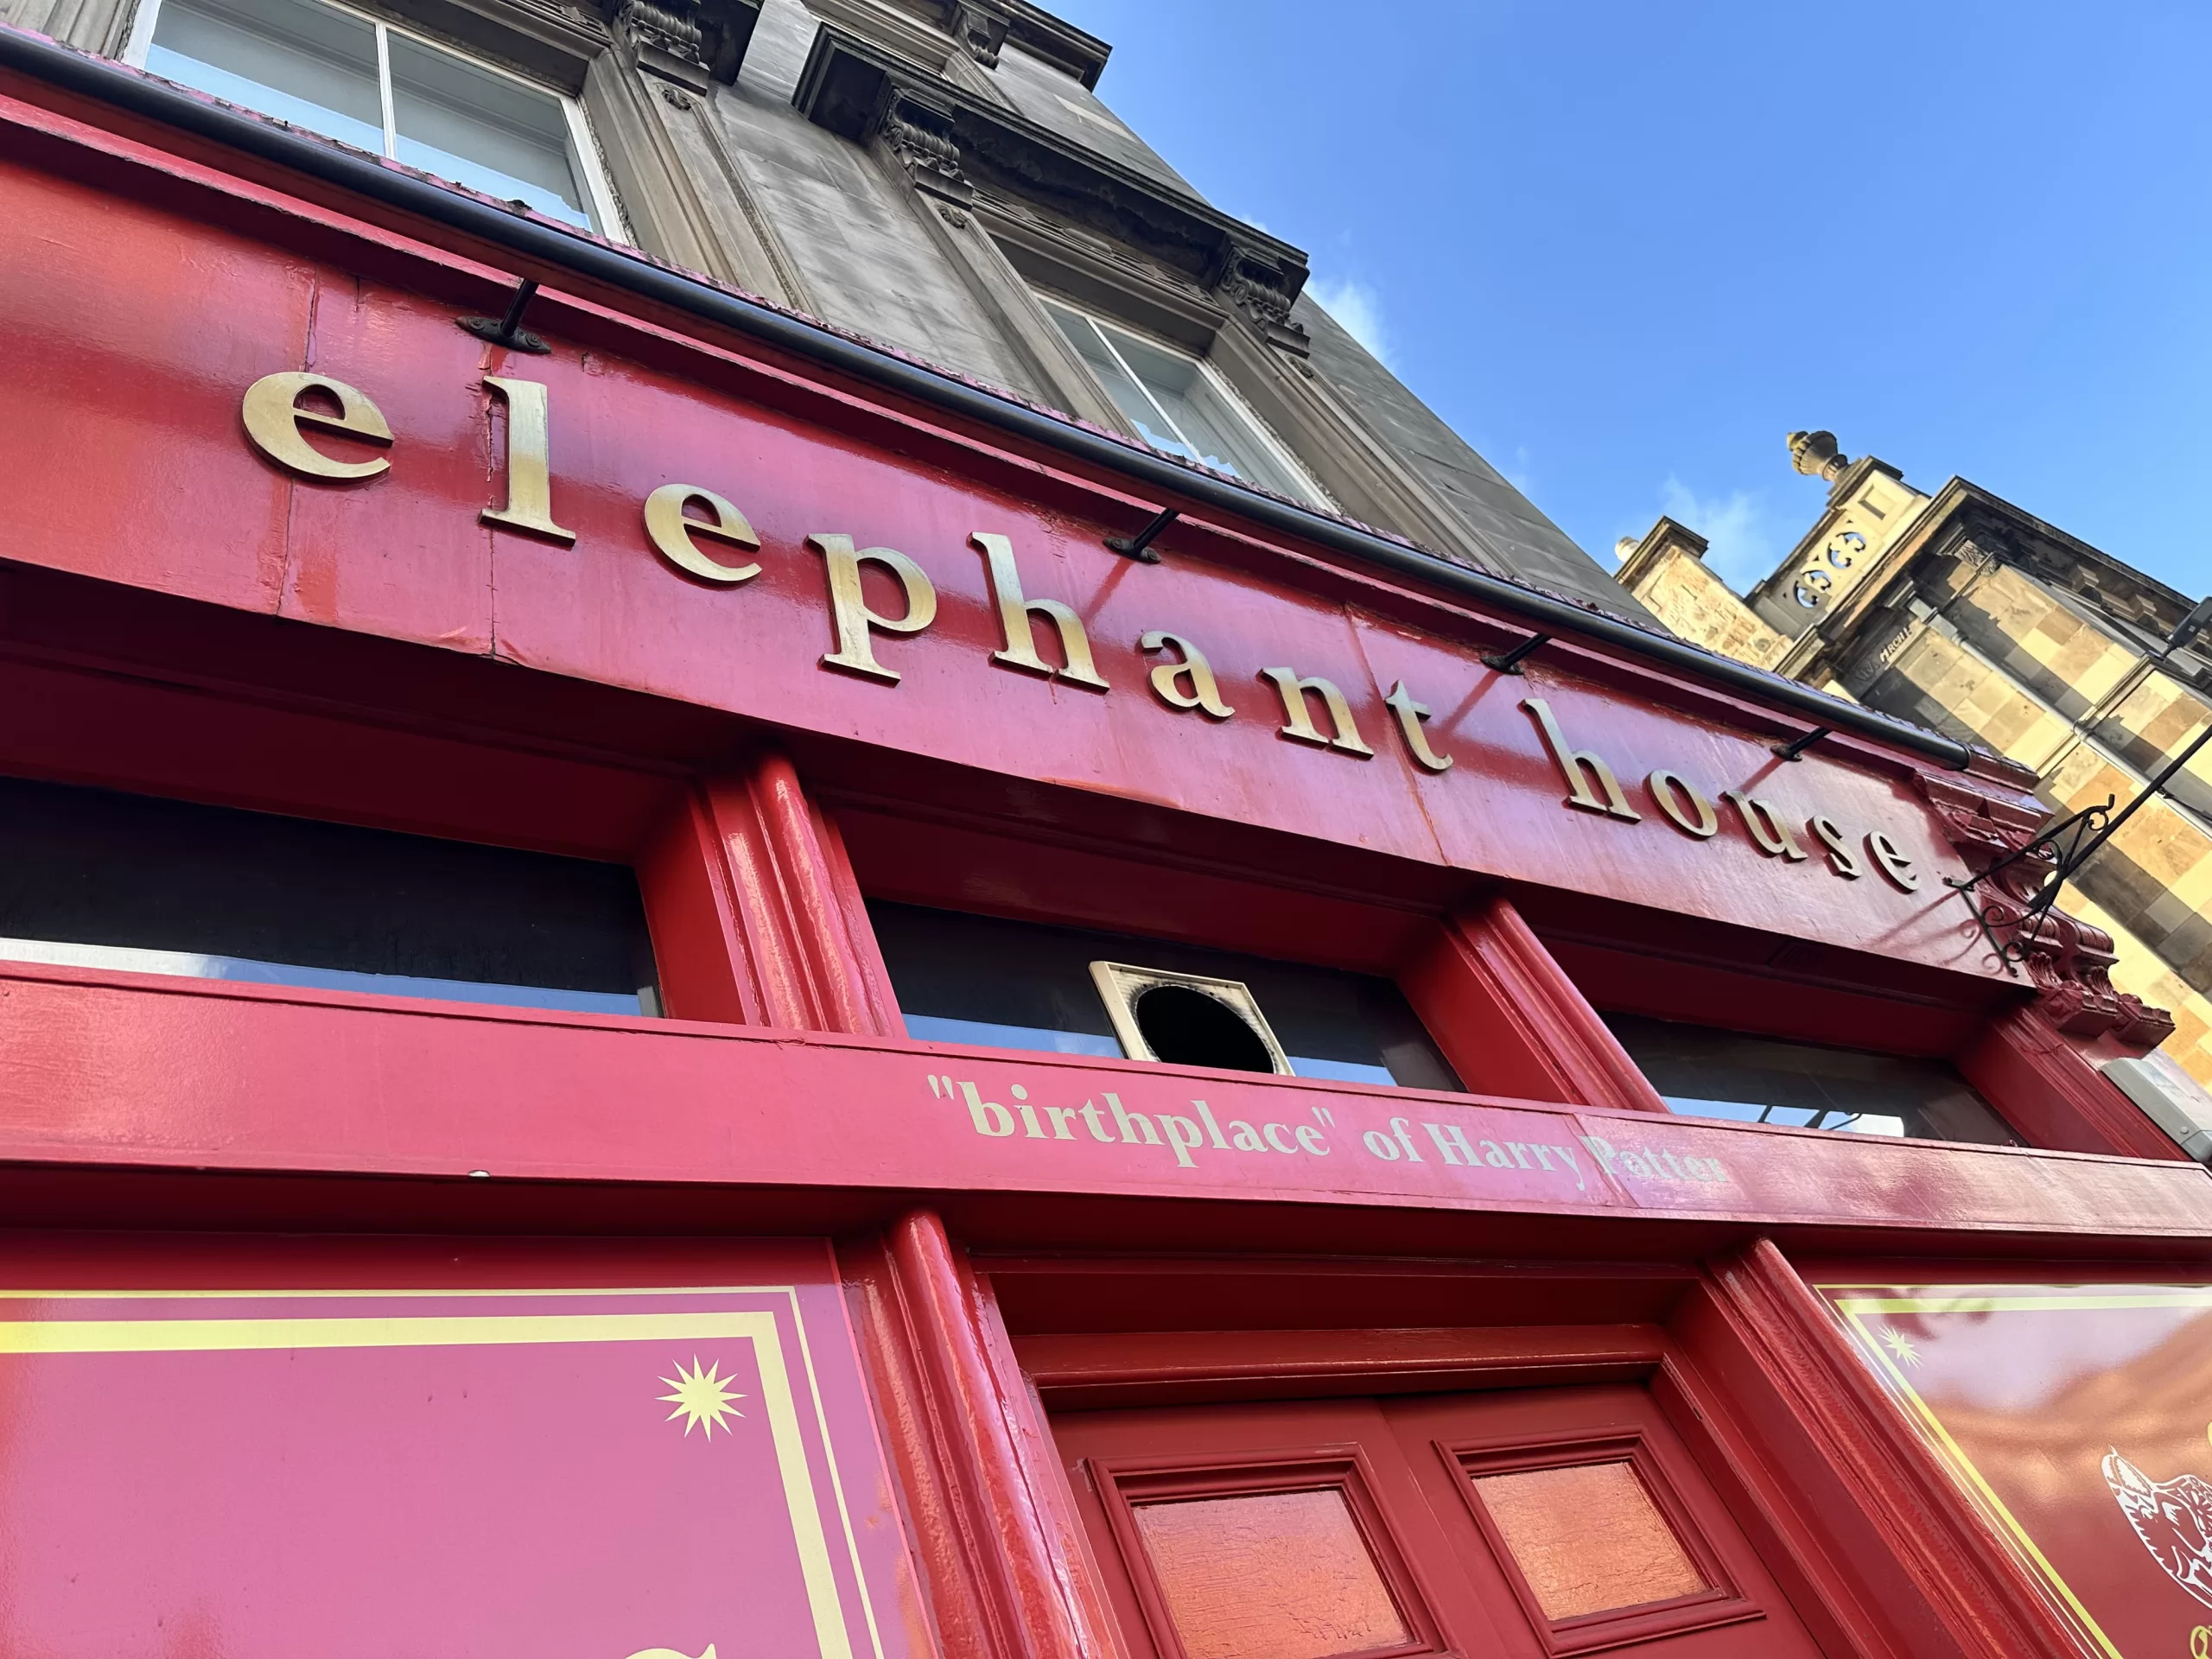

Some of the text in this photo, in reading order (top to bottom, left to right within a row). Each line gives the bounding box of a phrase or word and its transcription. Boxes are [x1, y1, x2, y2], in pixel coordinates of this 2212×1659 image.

[241, 371, 1922, 893] elephant house
[926, 1074, 1729, 1192] "birthplace" of Harry Potter
